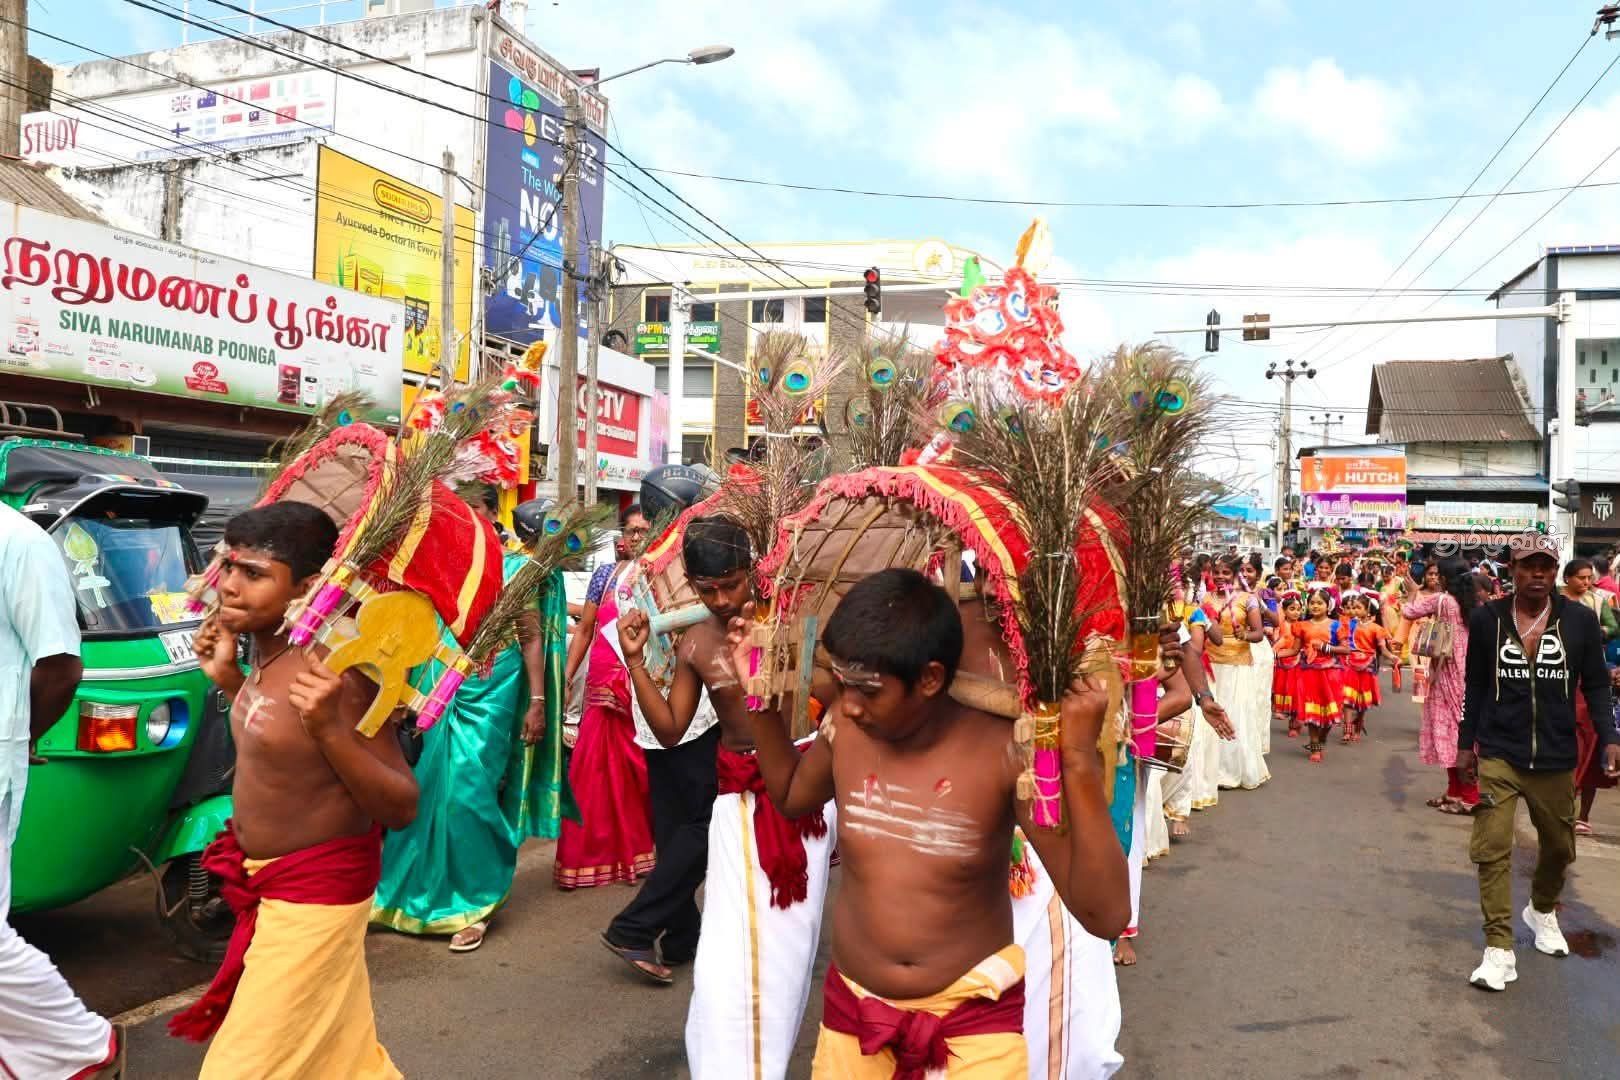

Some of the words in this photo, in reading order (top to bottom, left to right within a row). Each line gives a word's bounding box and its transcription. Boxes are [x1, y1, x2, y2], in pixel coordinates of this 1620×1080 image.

[24, 118, 80, 154] STUDY
[541, 115, 598, 171] EZIZ
[521, 166, 542, 192] The
[336, 212, 378, 235] Ayurveda
[379, 227, 408, 247] Doctor
[417, 241, 438, 261] Every
[59, 309, 102, 336] SIVA
[108, 318, 213, 355] NARUMANAB
[218, 339, 277, 367] POONGA
[1345, 471, 1400, 483] HUTCH
